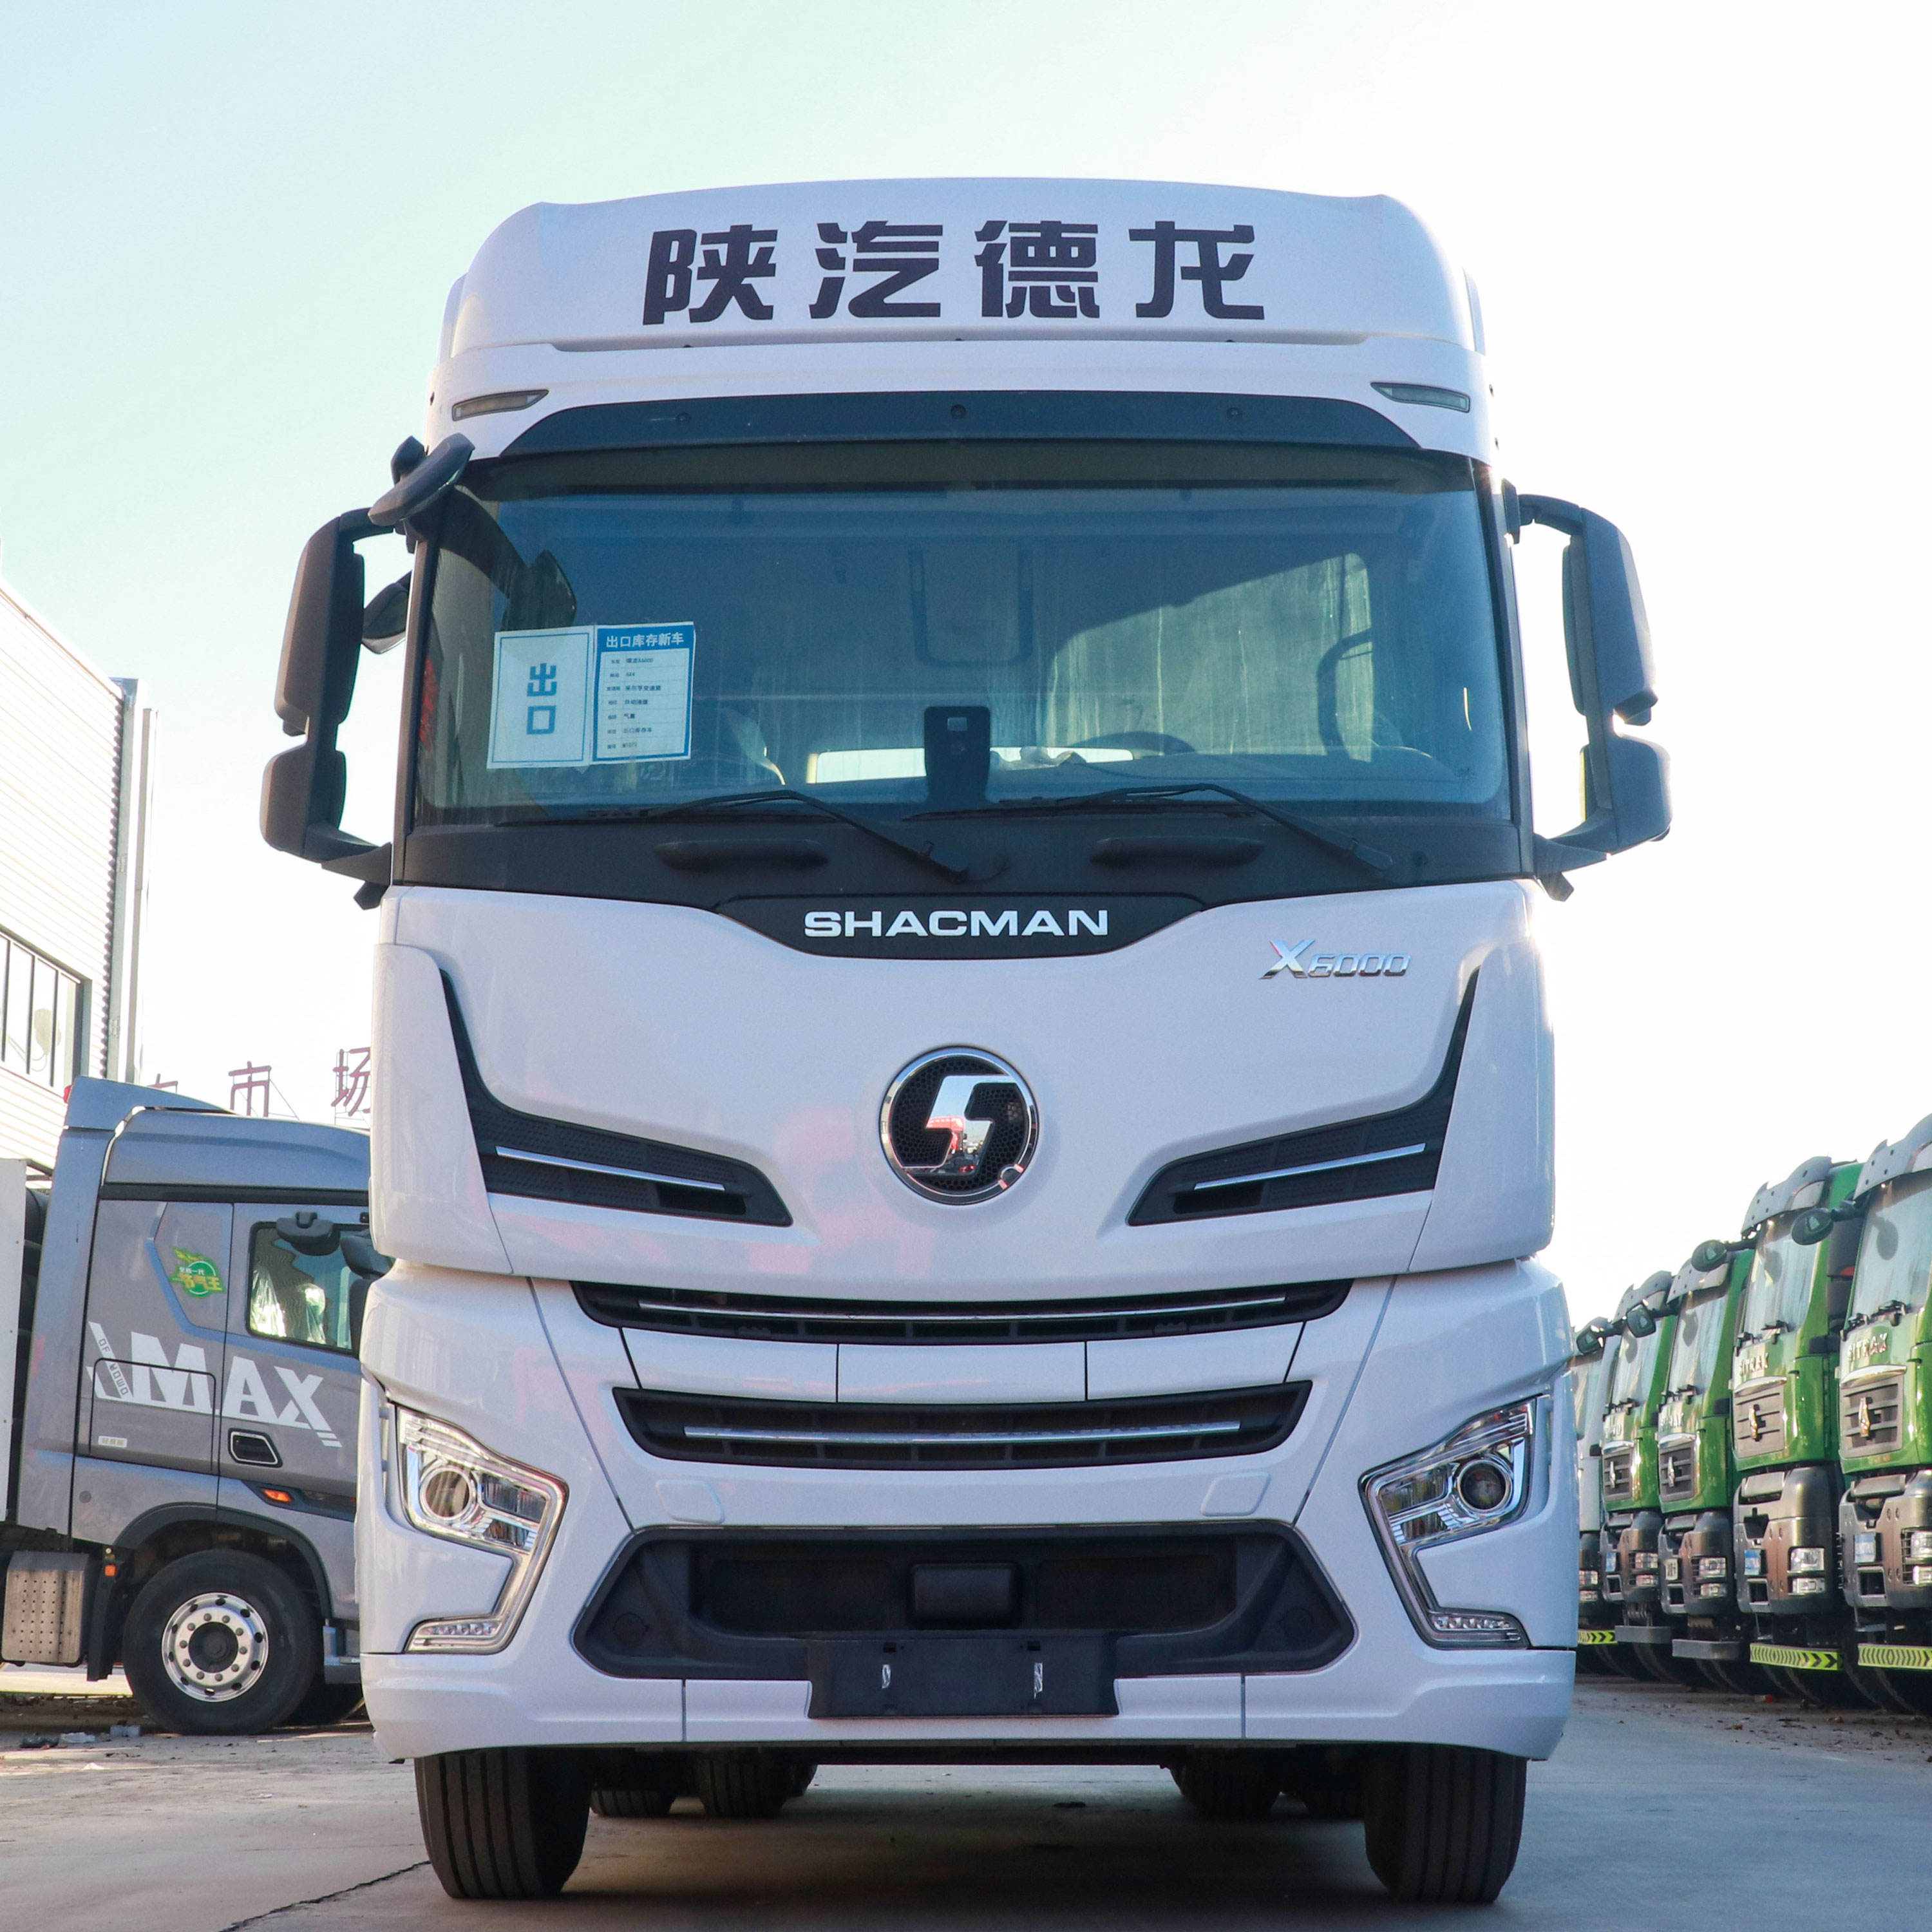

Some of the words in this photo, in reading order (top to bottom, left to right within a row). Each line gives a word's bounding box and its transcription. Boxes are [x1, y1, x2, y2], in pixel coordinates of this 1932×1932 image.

[643, 220, 1265, 325] 陕汽德龙
[605, 632, 685, 649] 出口库存新车
[526, 662, 558, 735] 出口
[804, 909, 1108, 937] SHACMAN
[1258, 938, 1411, 980] X6000
[1848, 1332, 1888, 1363] SITRAK
[131, 1331, 333, 1432] MAX
